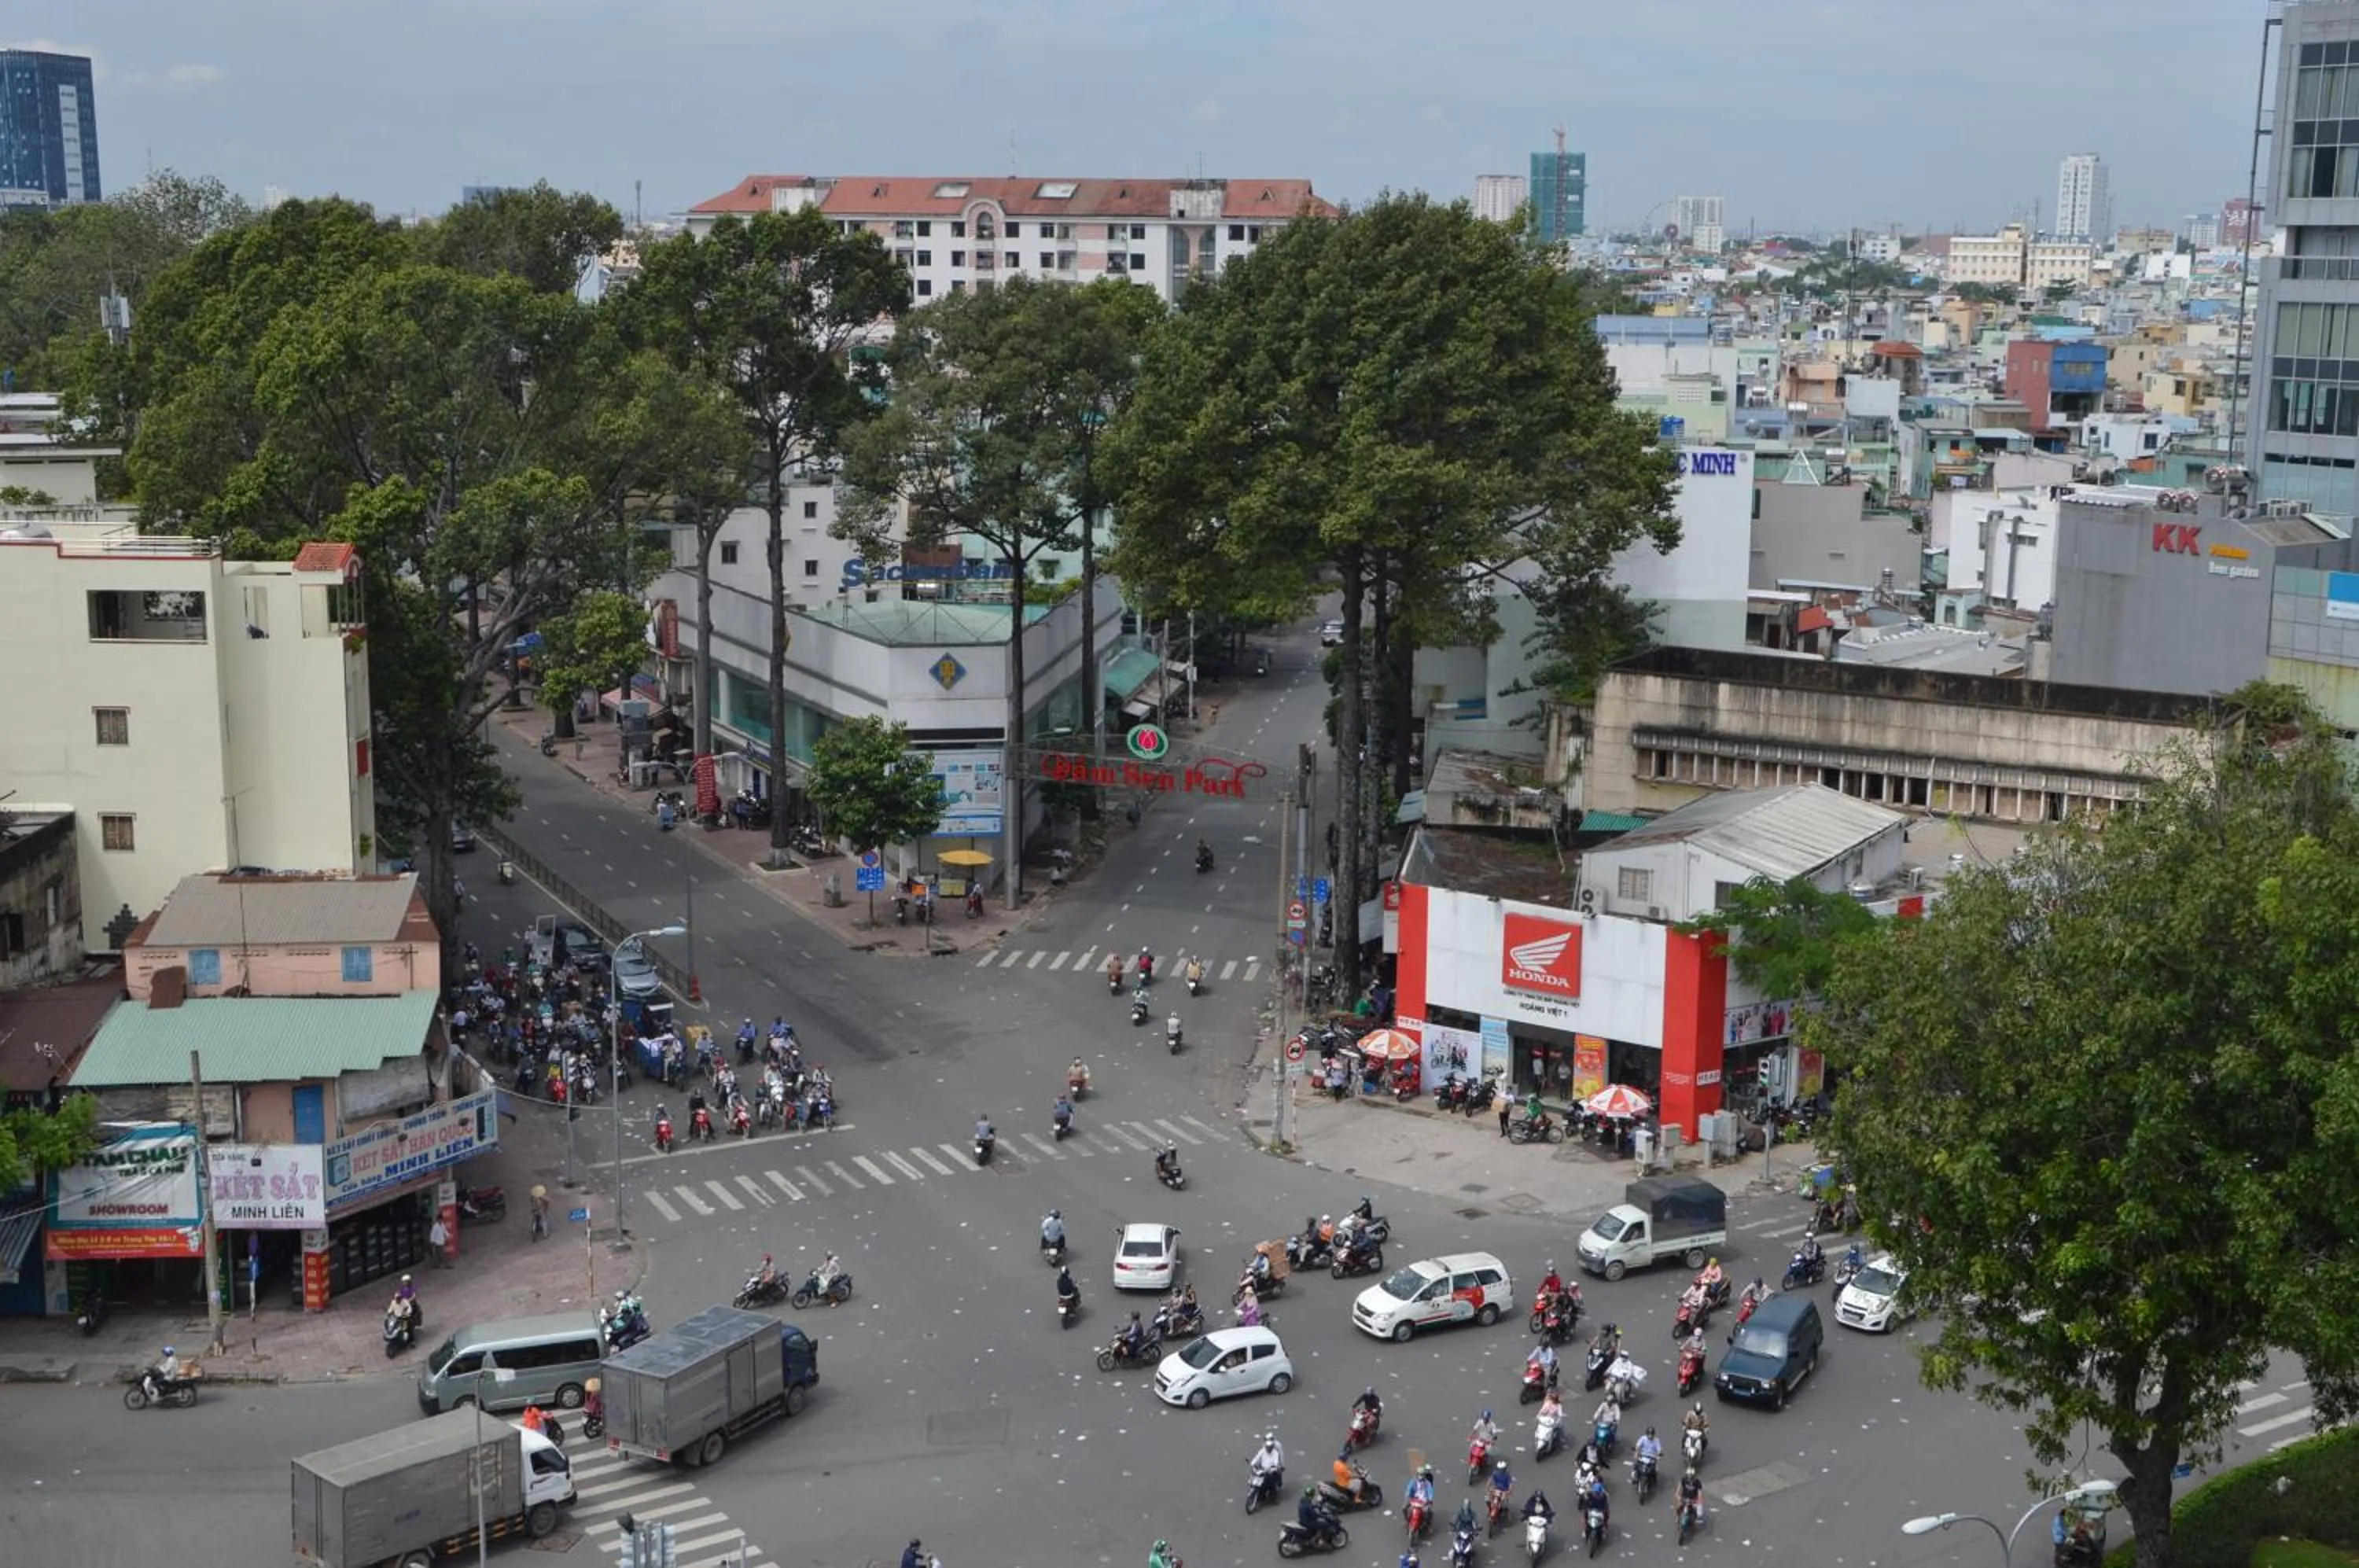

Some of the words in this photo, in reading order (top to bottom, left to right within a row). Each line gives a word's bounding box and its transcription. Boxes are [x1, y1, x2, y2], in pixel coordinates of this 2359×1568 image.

[1691, 451, 1736, 475] MINH
[2152, 522, 2201, 556] KK
[841, 558, 1024, 587] Sacomban
[1121, 760, 1176, 793] Sen
[1183, 758, 1267, 799] Park
[1508, 968, 1573, 991] HONDA
[385, 1152, 429, 1177] MINH
[89, 1202, 168, 1216] SHOWROOM
[231, 1205, 267, 1219] MINH
